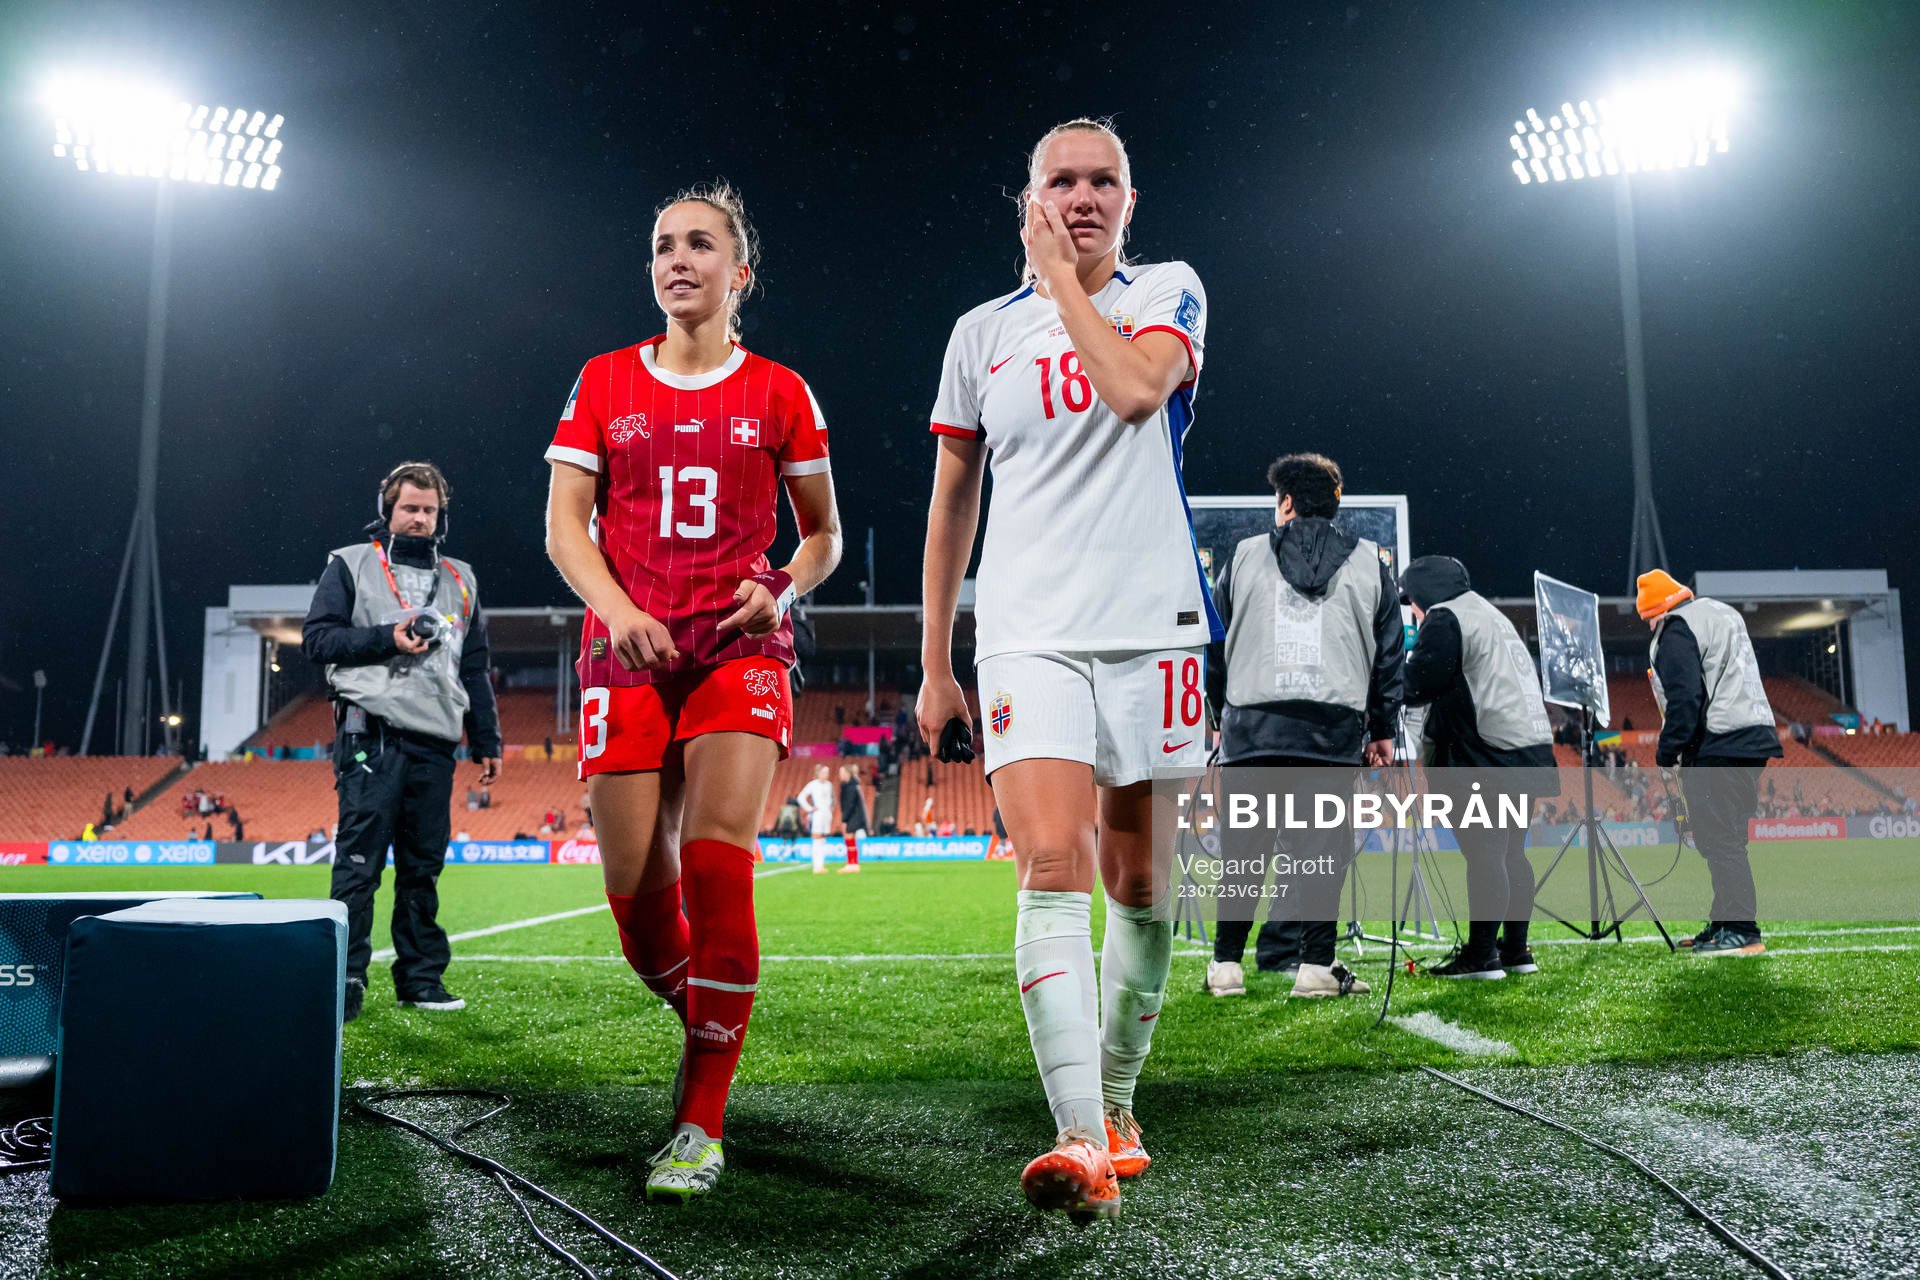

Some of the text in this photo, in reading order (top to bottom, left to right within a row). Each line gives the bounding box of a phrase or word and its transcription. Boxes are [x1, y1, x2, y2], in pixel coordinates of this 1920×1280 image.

[1035, 351, 1092, 419] 18
[674, 424, 700, 433] PUMA
[659, 466, 718, 539] 13
[1158, 656, 1202, 729] 18
[751, 707, 774, 720] PUMA
[1754, 822, 1839, 838] McDonald's
[1869, 815, 1920, 839] Glob
[76, 844, 129, 862] xero
[158, 844, 212, 862] xero
[862, 843, 899, 856] NEW
[903, 842, 983, 856] ZEALAND
